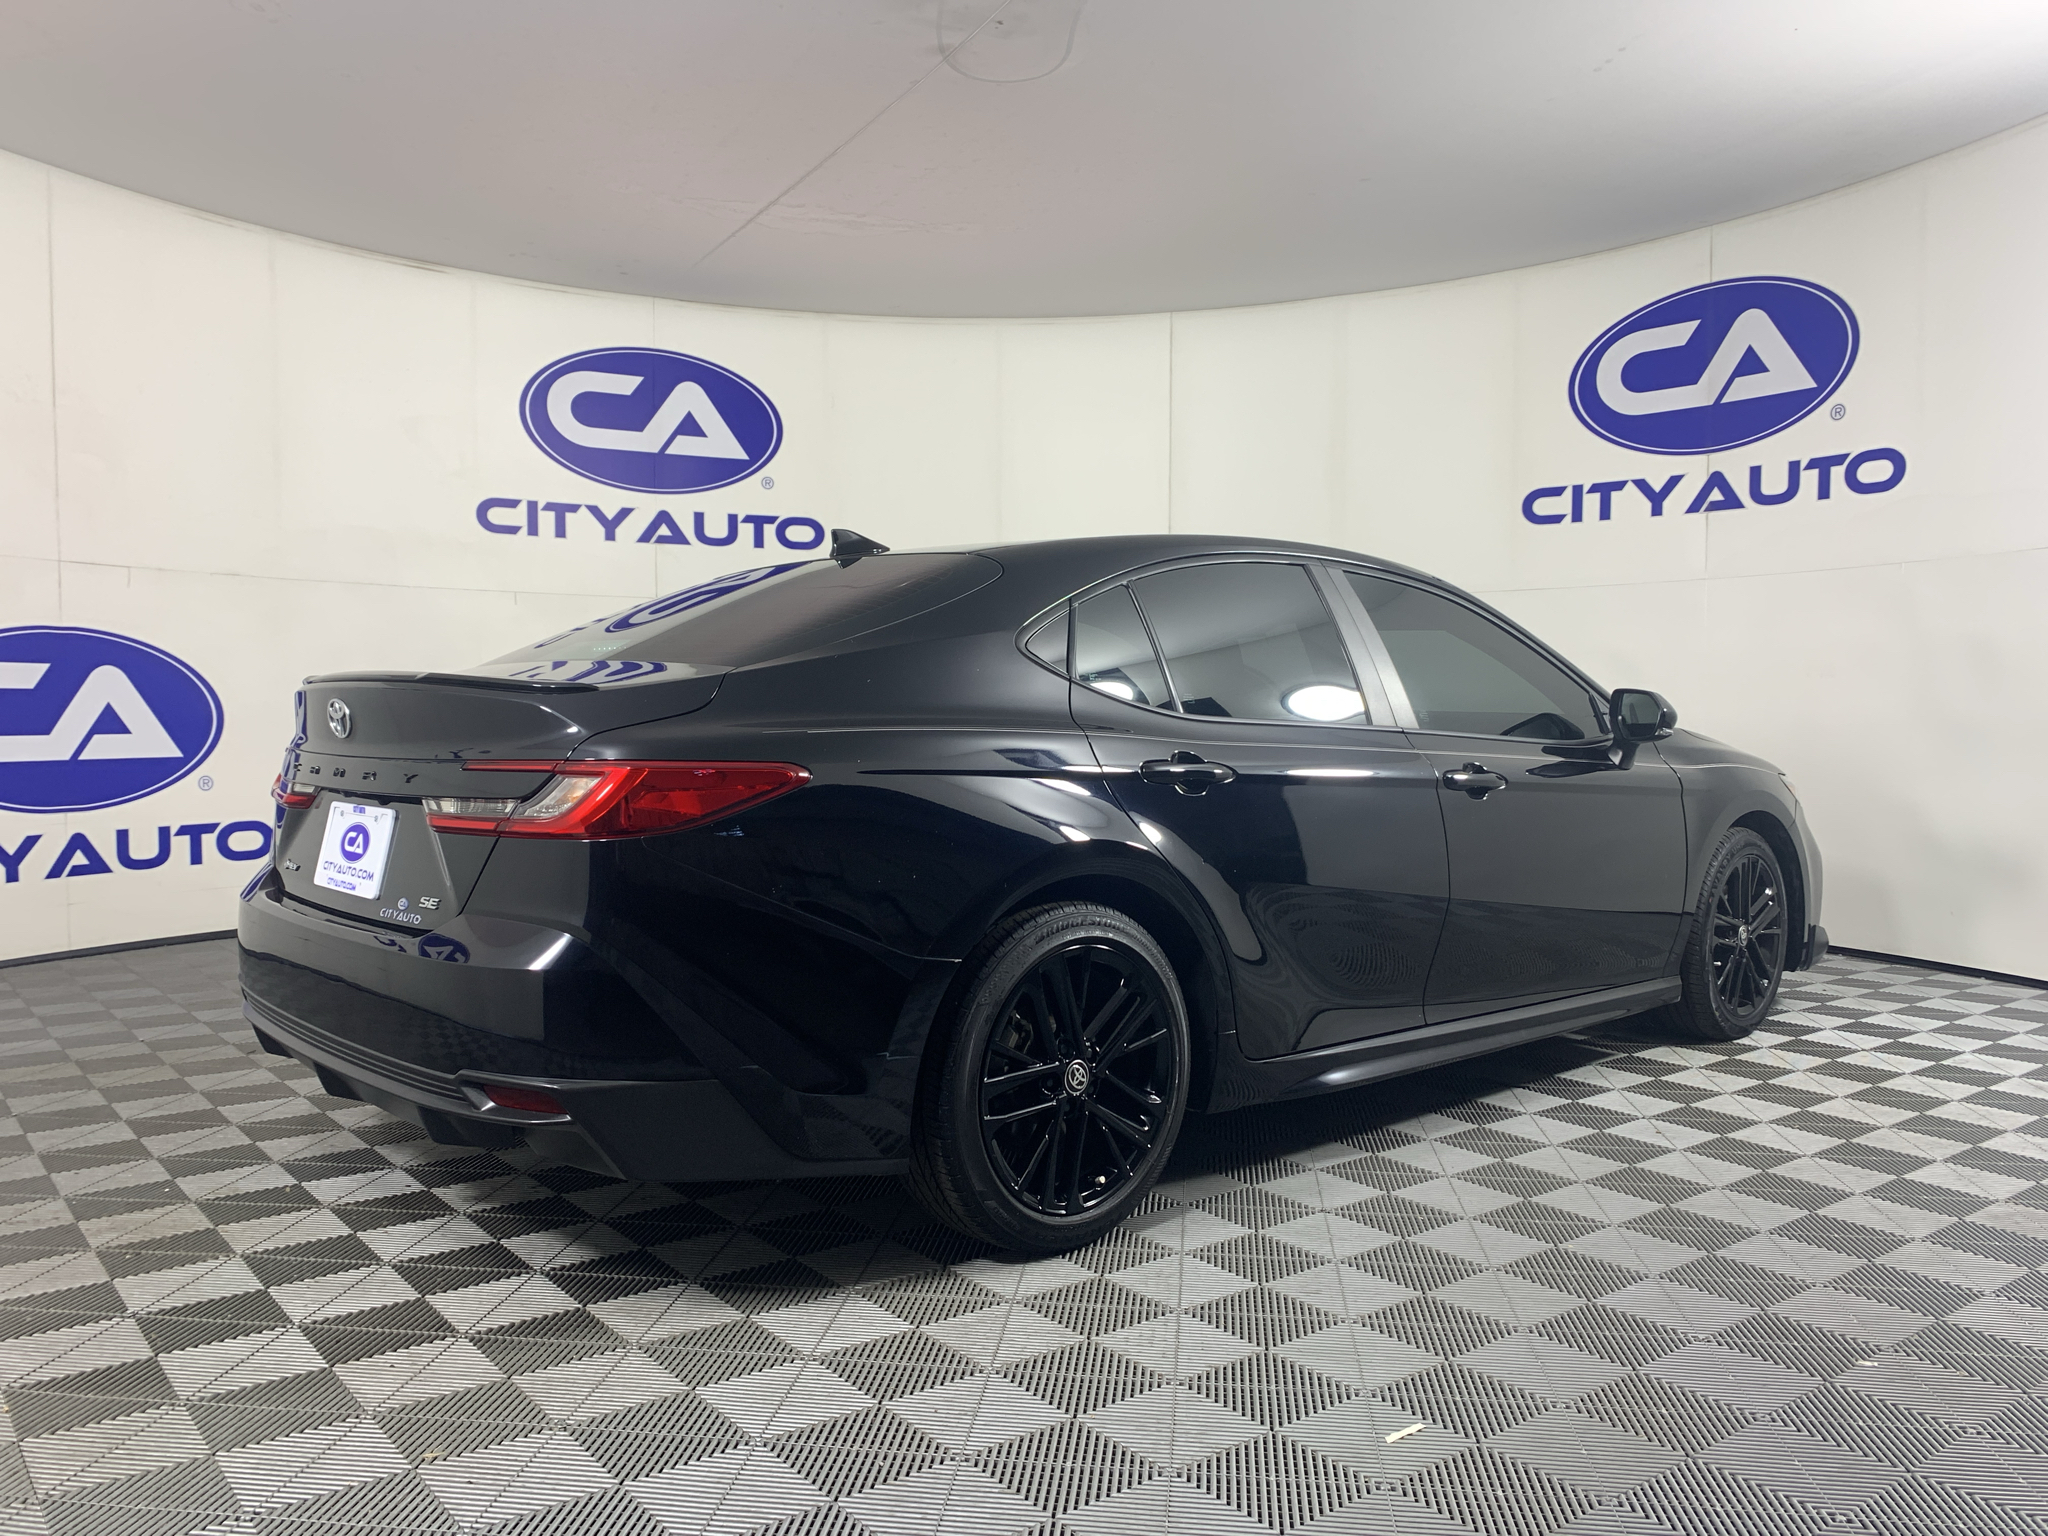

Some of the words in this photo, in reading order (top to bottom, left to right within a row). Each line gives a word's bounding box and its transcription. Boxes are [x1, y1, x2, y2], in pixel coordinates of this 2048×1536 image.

[1596, 308, 1818, 416] CA
[547, 370, 750, 461] CA
[344, 831, 364, 855] CA
[418, 896, 440, 910] SE
